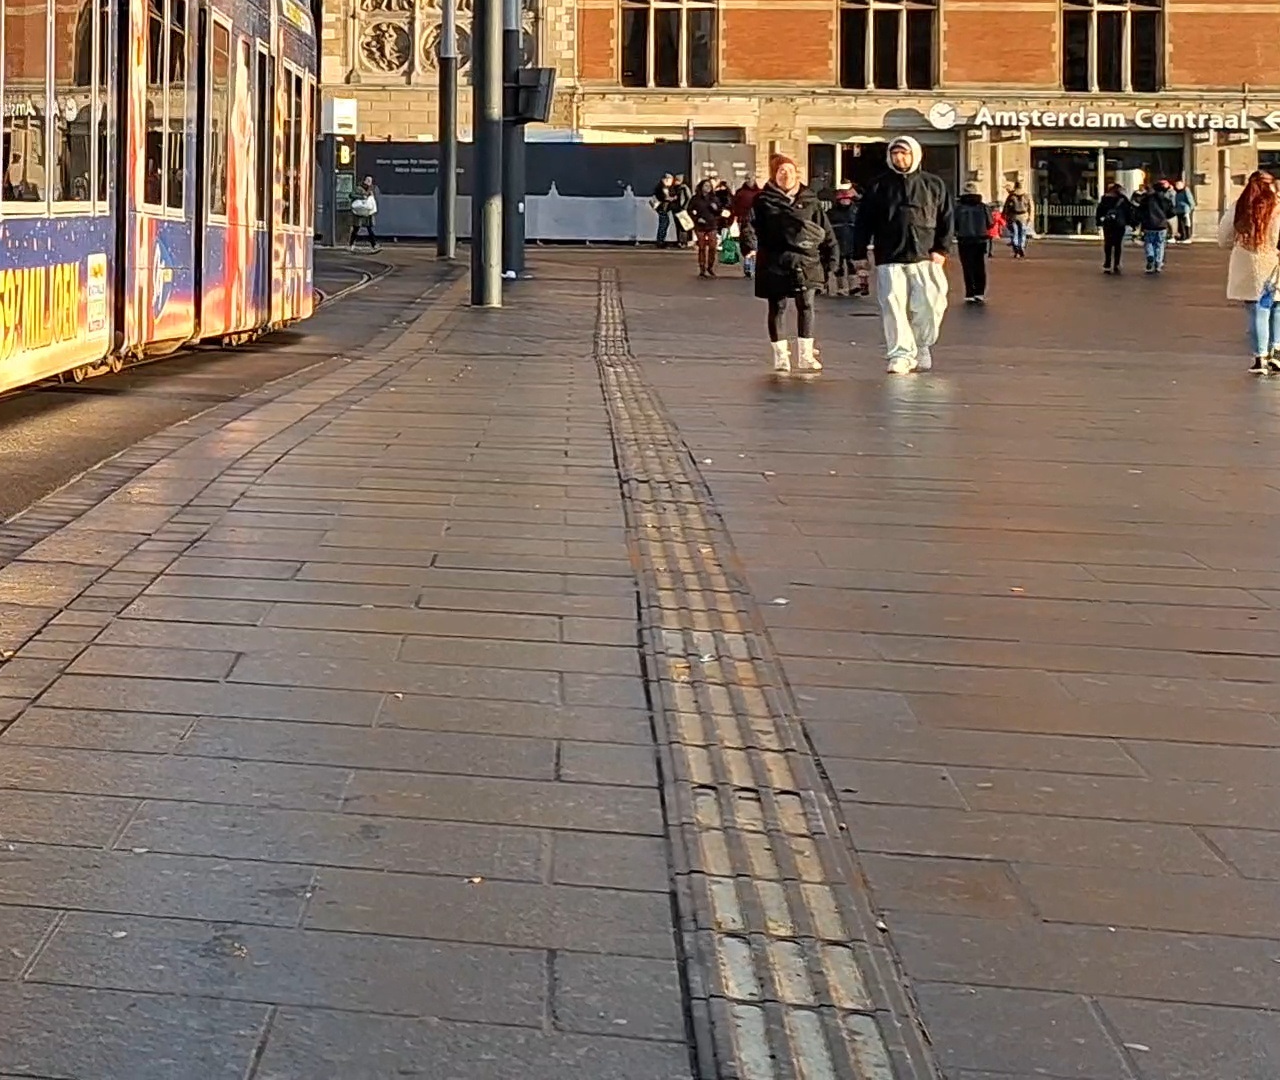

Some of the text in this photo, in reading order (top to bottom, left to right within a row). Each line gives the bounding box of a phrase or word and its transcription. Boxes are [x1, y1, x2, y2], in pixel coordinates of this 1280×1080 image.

[974, 106, 1247, 130] Amsterdam Centraal
[22, 260, 80, 352] MILJOEN
